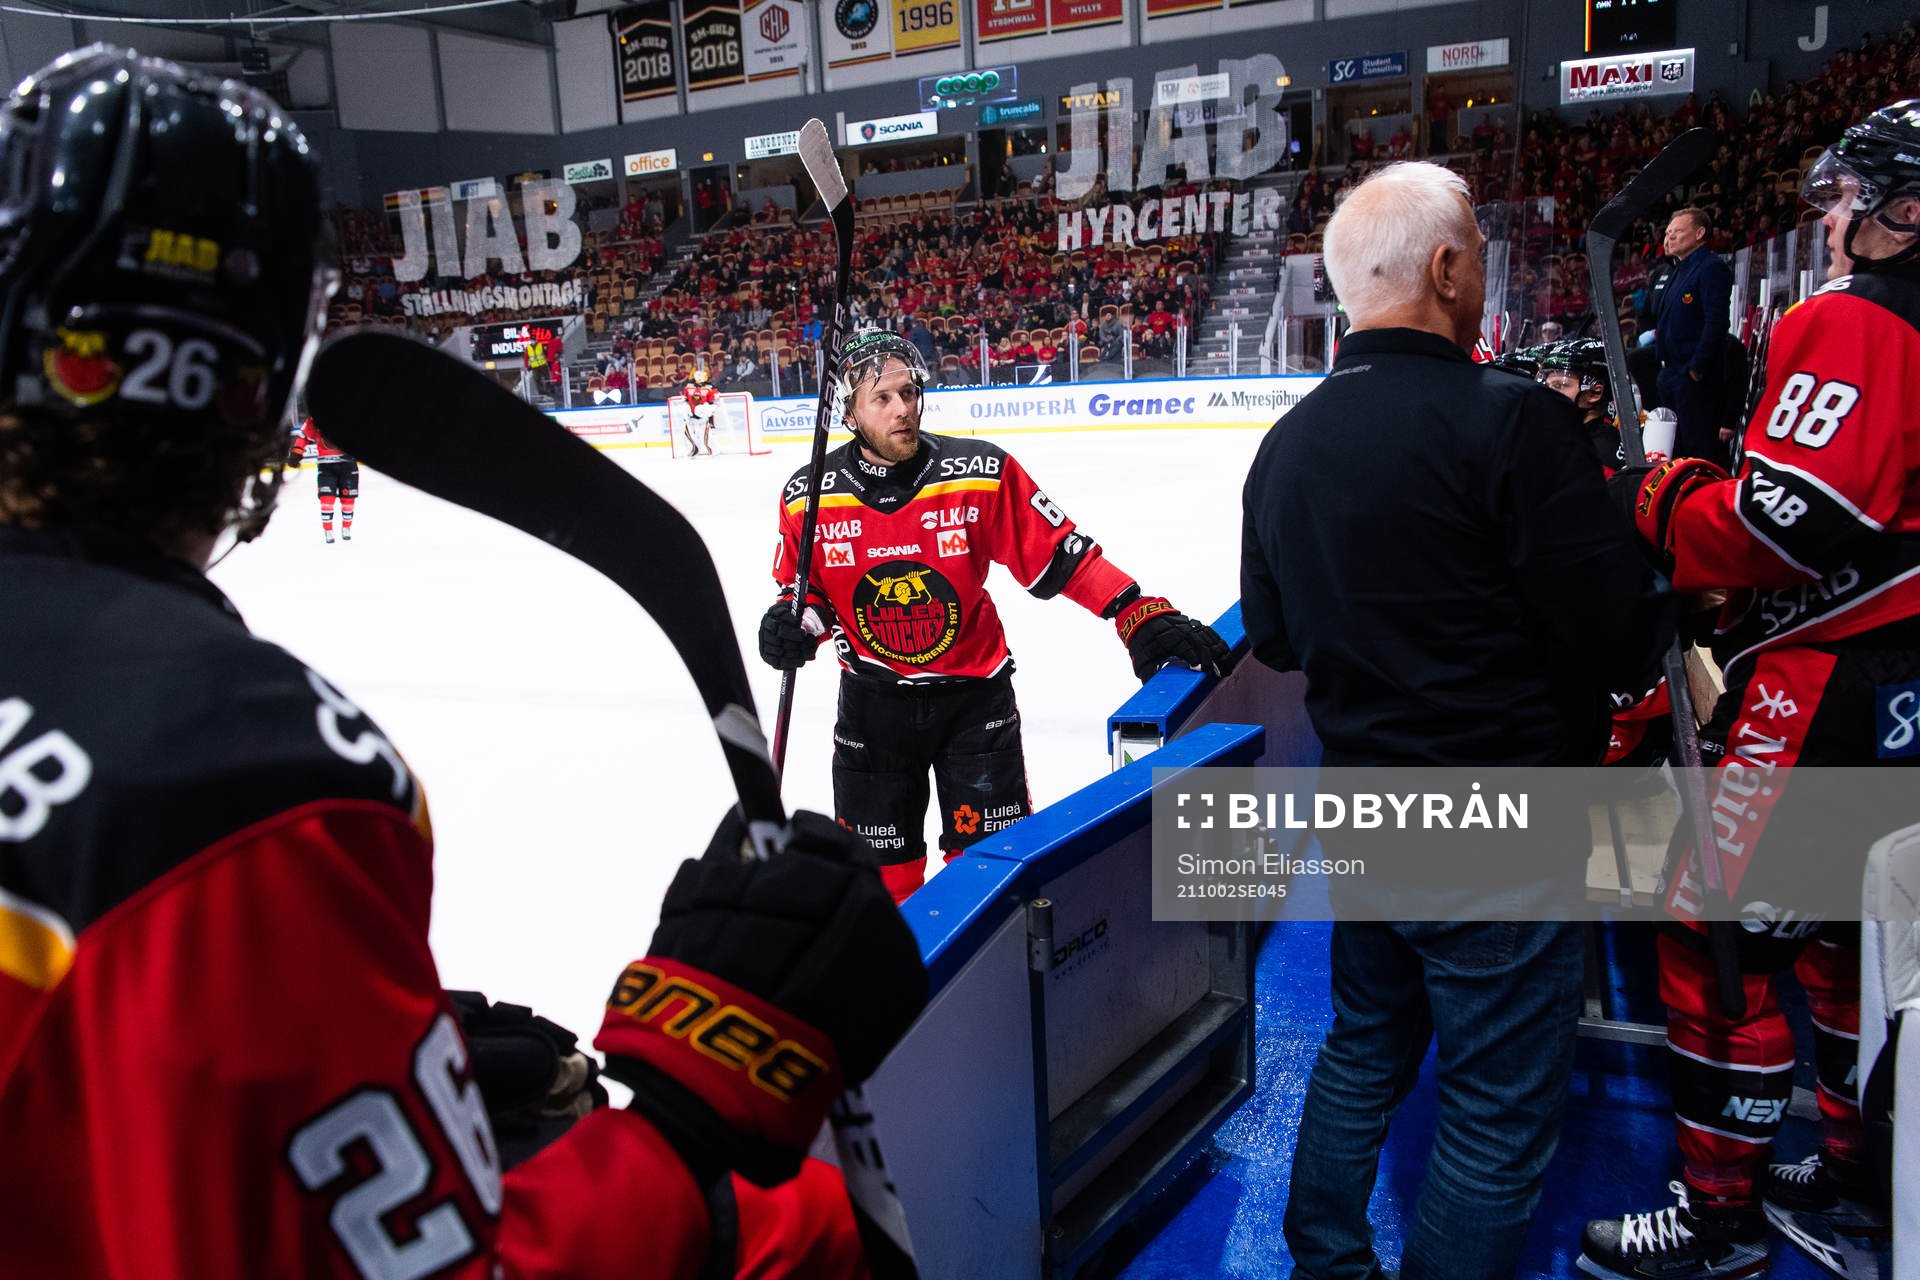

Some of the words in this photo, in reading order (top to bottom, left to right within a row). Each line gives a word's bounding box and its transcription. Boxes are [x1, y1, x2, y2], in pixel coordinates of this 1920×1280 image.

[761, 8, 789, 40] CHL
[898, 1, 954, 33] 1996
[1797, 5, 1829, 51] J
[690, 41, 739, 72] 2016
[1362, 58, 1391, 67] Student
[1442, 45, 1479, 63] NORD
[625, 53, 672, 83] 2018
[1570, 64, 1653, 88] MAXI
[935, 70, 1000, 95] coop
[1062, 91, 1120, 110] TITAN
[879, 121, 923, 135] SCANIA
[1055, 53, 1287, 200] JIAB
[629, 154, 670, 174] office
[393, 177, 582, 282] JIAB
[1058, 187, 1286, 251] HYRCENTER
[402, 279, 583, 317] STÄLLNINGSMONTAGE
[503, 327, 520, 340] BIL
[118, 329, 218, 408] 26
[970, 397, 1076, 420] OJANPERÄ
[1089, 393, 1196, 417] Granec
[1766, 372, 1860, 450] 88
[765, 411, 839, 428] ÄLVSBYS
[858, 459, 887, 477] SSAB
[939, 455, 1000, 477] SSAB
[785, 471, 837, 501] SSB
[867, 543, 922, 558] SCANIA
[866, 598, 945, 621] LULEÅ
[855, 608, 874, 641] LULEÅ
[871, 628, 956, 664] HOCKEYFÖRENING
[947, 602, 958, 626] 1977
[869, 617, 945, 653] HOCKEY
[1883, 690, 1920, 750] S
[984, 801, 1021, 818] Luleå
[856, 823, 896, 838] Luleå
[865, 834, 905, 849] nergi
[1721, 1096, 1788, 1123] NEX
